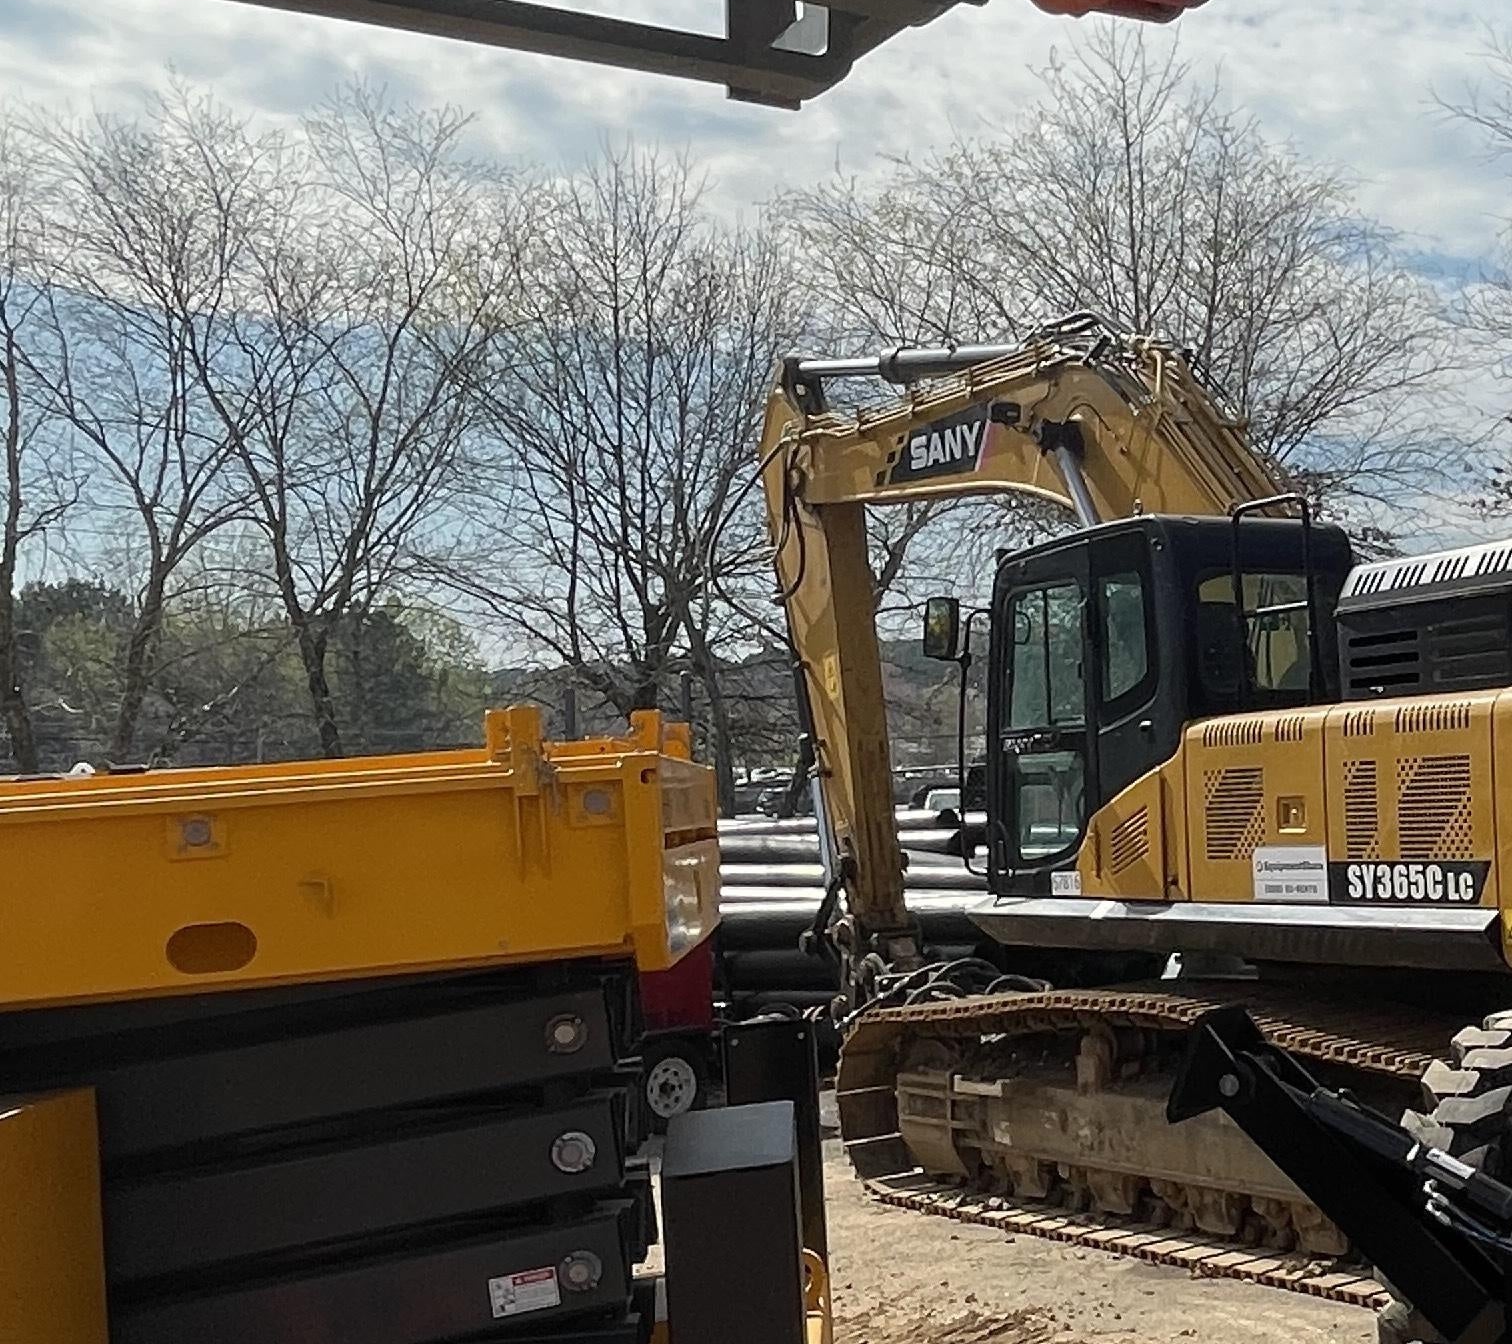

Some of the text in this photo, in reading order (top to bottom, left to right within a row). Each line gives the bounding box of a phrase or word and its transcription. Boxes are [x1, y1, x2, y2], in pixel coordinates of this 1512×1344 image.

[910, 420, 981, 469] SANY
[1346, 864, 1474, 901] SY365C LC
